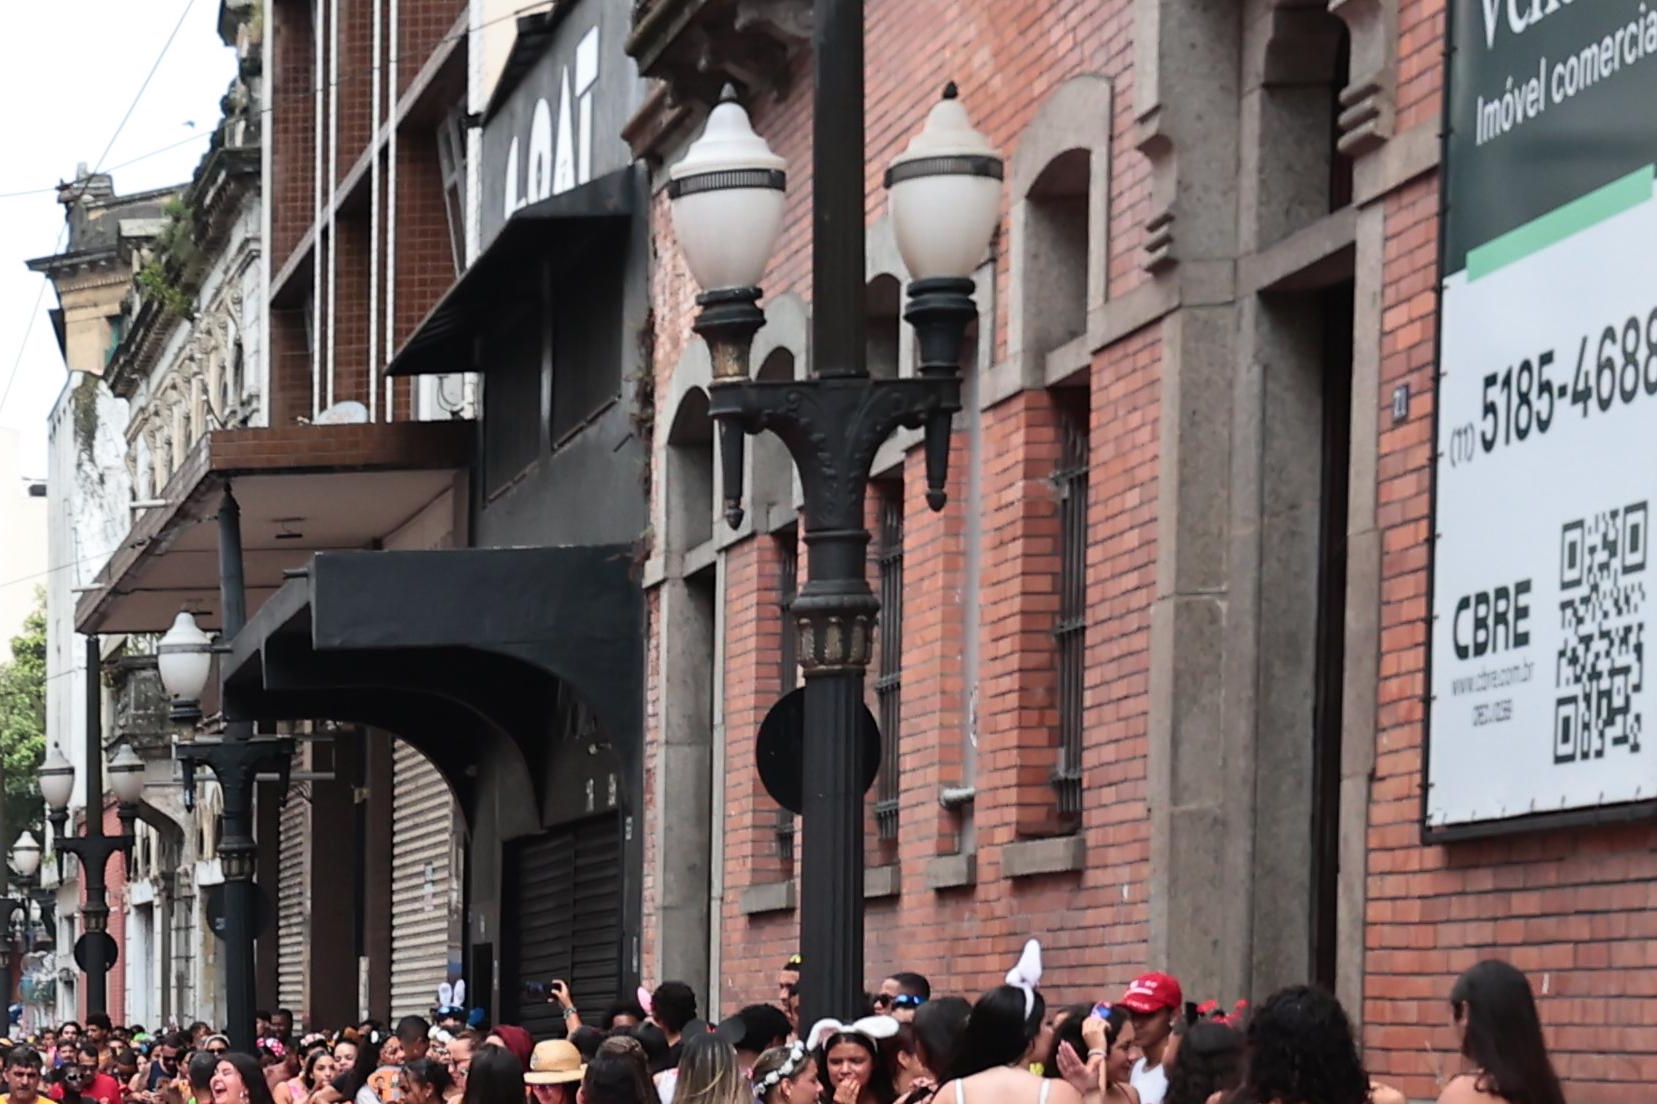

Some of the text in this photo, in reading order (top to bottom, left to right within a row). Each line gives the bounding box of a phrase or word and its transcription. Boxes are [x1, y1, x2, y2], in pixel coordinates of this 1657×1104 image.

[1476, 57, 1546, 146] Imóvel
[1480, 305, 1657, 454] 5185-4688
[1452, 578, 1532, 661] CBRE
